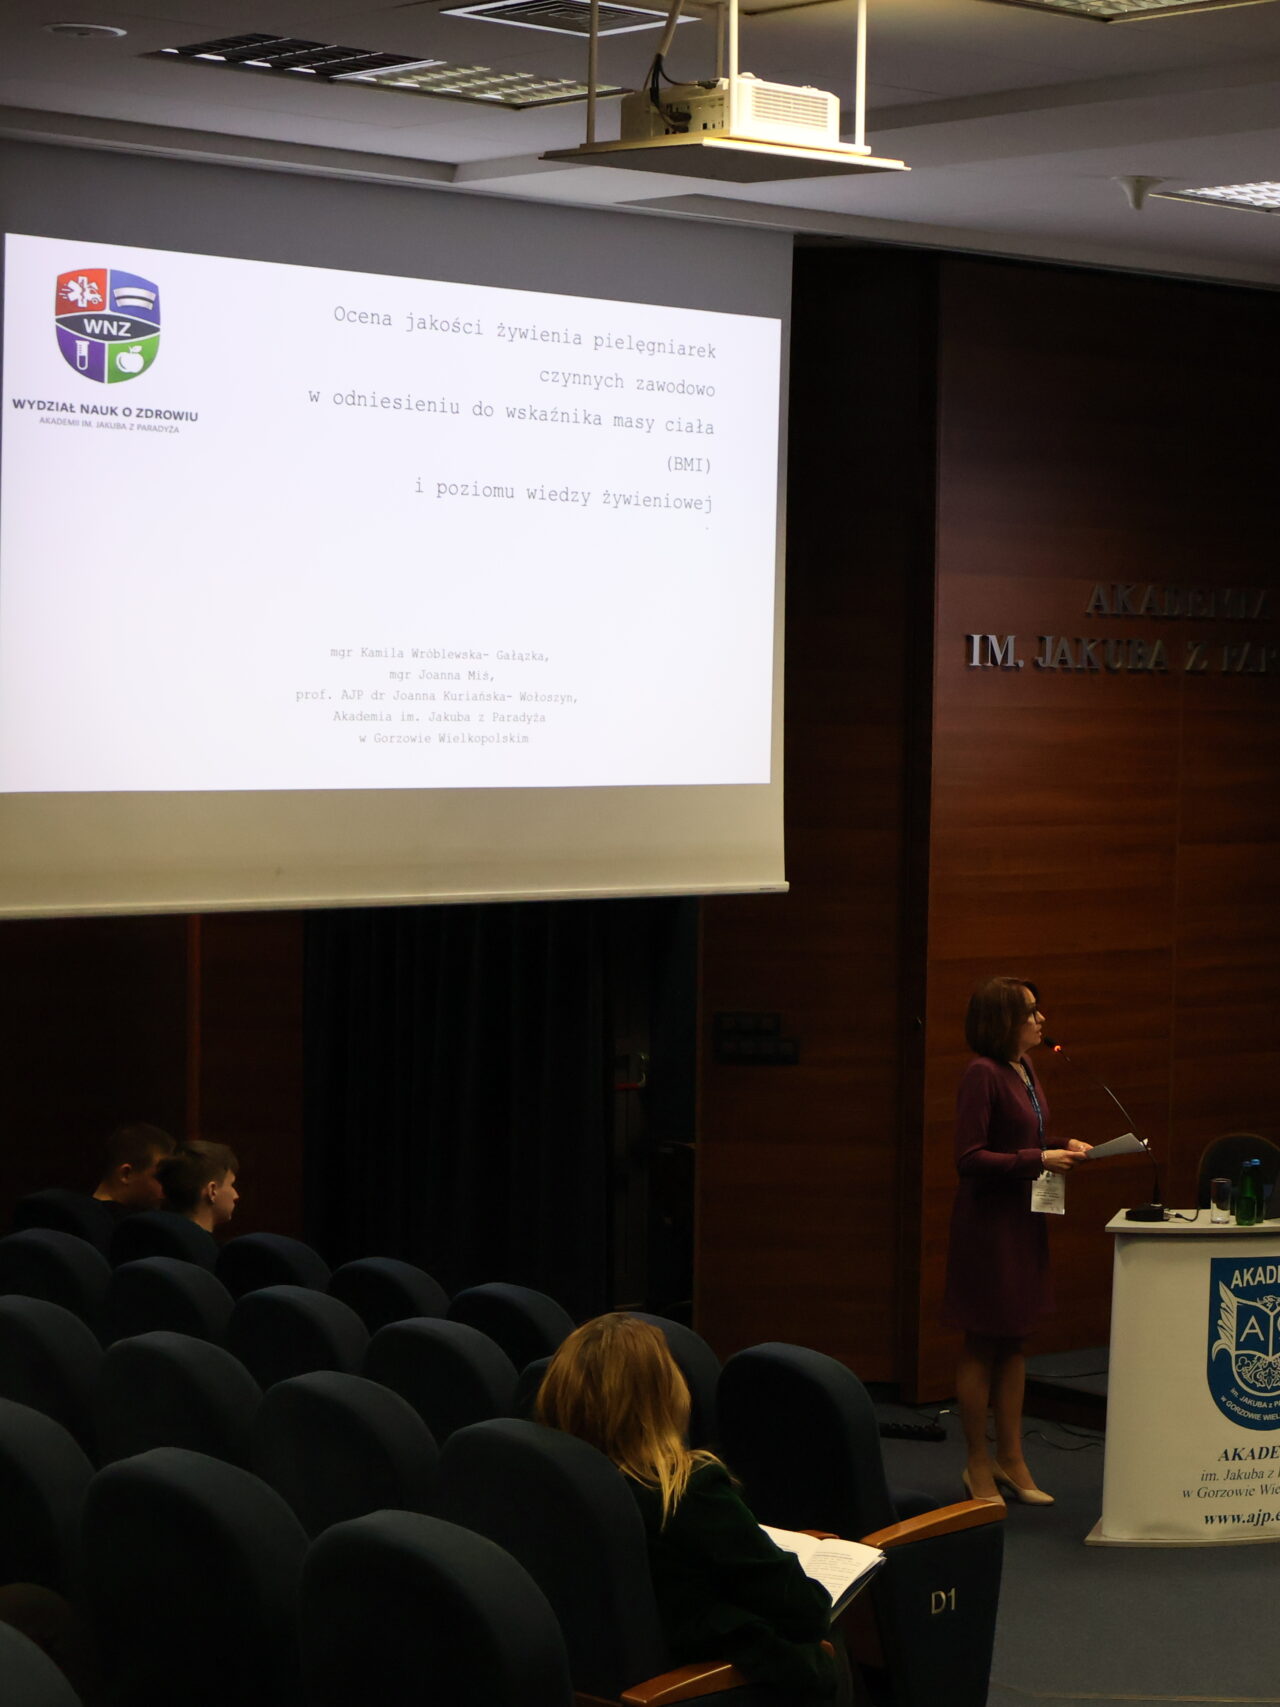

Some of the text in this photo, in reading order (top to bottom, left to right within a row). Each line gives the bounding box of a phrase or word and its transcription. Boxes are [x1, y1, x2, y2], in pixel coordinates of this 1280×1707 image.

[84, 319, 131, 336] WNZ
[334, 306, 716, 358] Ocena jakości żywienia pielęgniarek
[539, 368, 715, 397] czynnych zawodowo
[12, 399, 198, 421] WYDZIAŁ NAUK O ZDROWIU
[309, 390, 714, 434] w odniesieniu do wskaźnika masy ciała
[40, 417, 79, 427] AKADEMII
[668, 456, 710, 474] (BMI)
[415, 477, 711, 514] i poziomu wiedzy żywieniowej
[330, 649, 352, 659] mgr
[360, 648, 404, 658] Kamila
[967, 633, 1024, 668] IM.
[1034, 634, 1168, 671] JAKUBA
[1183, 640, 1209, 672] Z
[390, 671, 411, 681] mgr
[419, 669, 460, 680] Joanna
[296, 689, 332, 702] prof.
[341, 690, 363, 700] AJP
[371, 690, 386, 700] dr
[392, 690, 436, 701] Joanna
[333, 711, 546, 726] Akademia im. Jakuba z Paradyża
[359, 733, 529, 746] w Gorzowie Wielkopolskim
[1225, 1400, 1262, 1420] GORZOWIE
[1239, 1395, 1268, 1409] JAKUBA
[1201, 1470, 1219, 1482] im.
[1223, 1468, 1264, 1480] Jakuba
[1267, 1470, 1274, 1478] z
[1183, 1489, 1192, 1498] w
[1197, 1486, 1255, 1498] Gorzowie
[931, 1587, 957, 1615] D1
